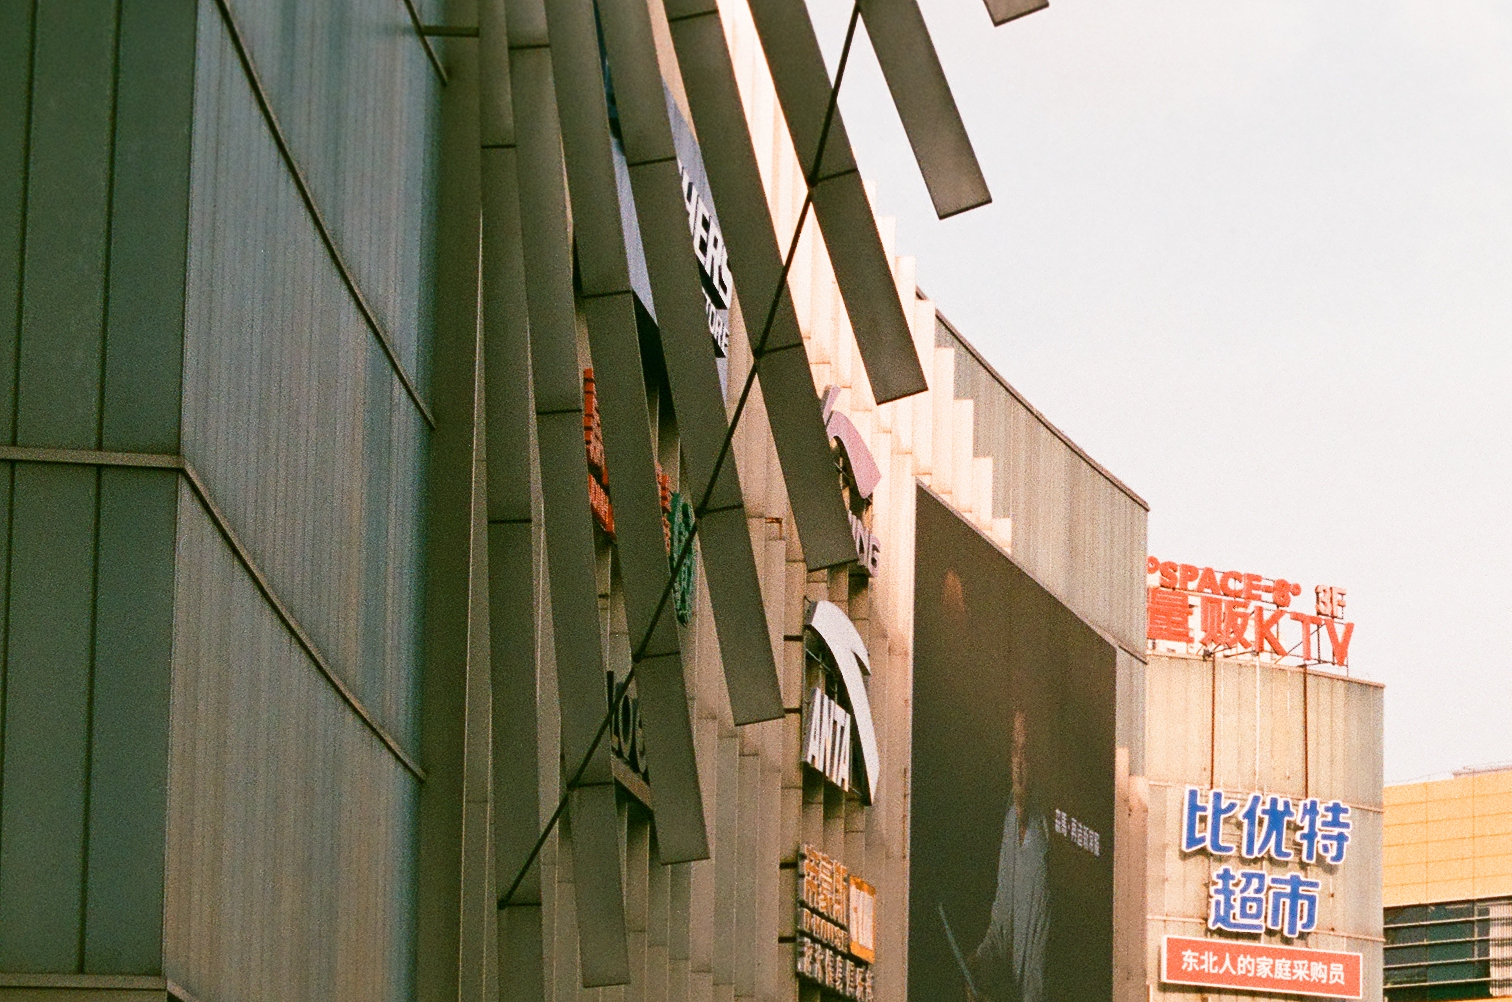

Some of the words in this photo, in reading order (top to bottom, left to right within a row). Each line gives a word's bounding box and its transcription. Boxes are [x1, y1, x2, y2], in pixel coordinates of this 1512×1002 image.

[806, 687, 851, 793] ANTA
[1182, 785, 1352, 864] 比优特
[1208, 866, 1321, 937] 超市
[1181, 950, 1346, 985] 东北人的家庭采购员
